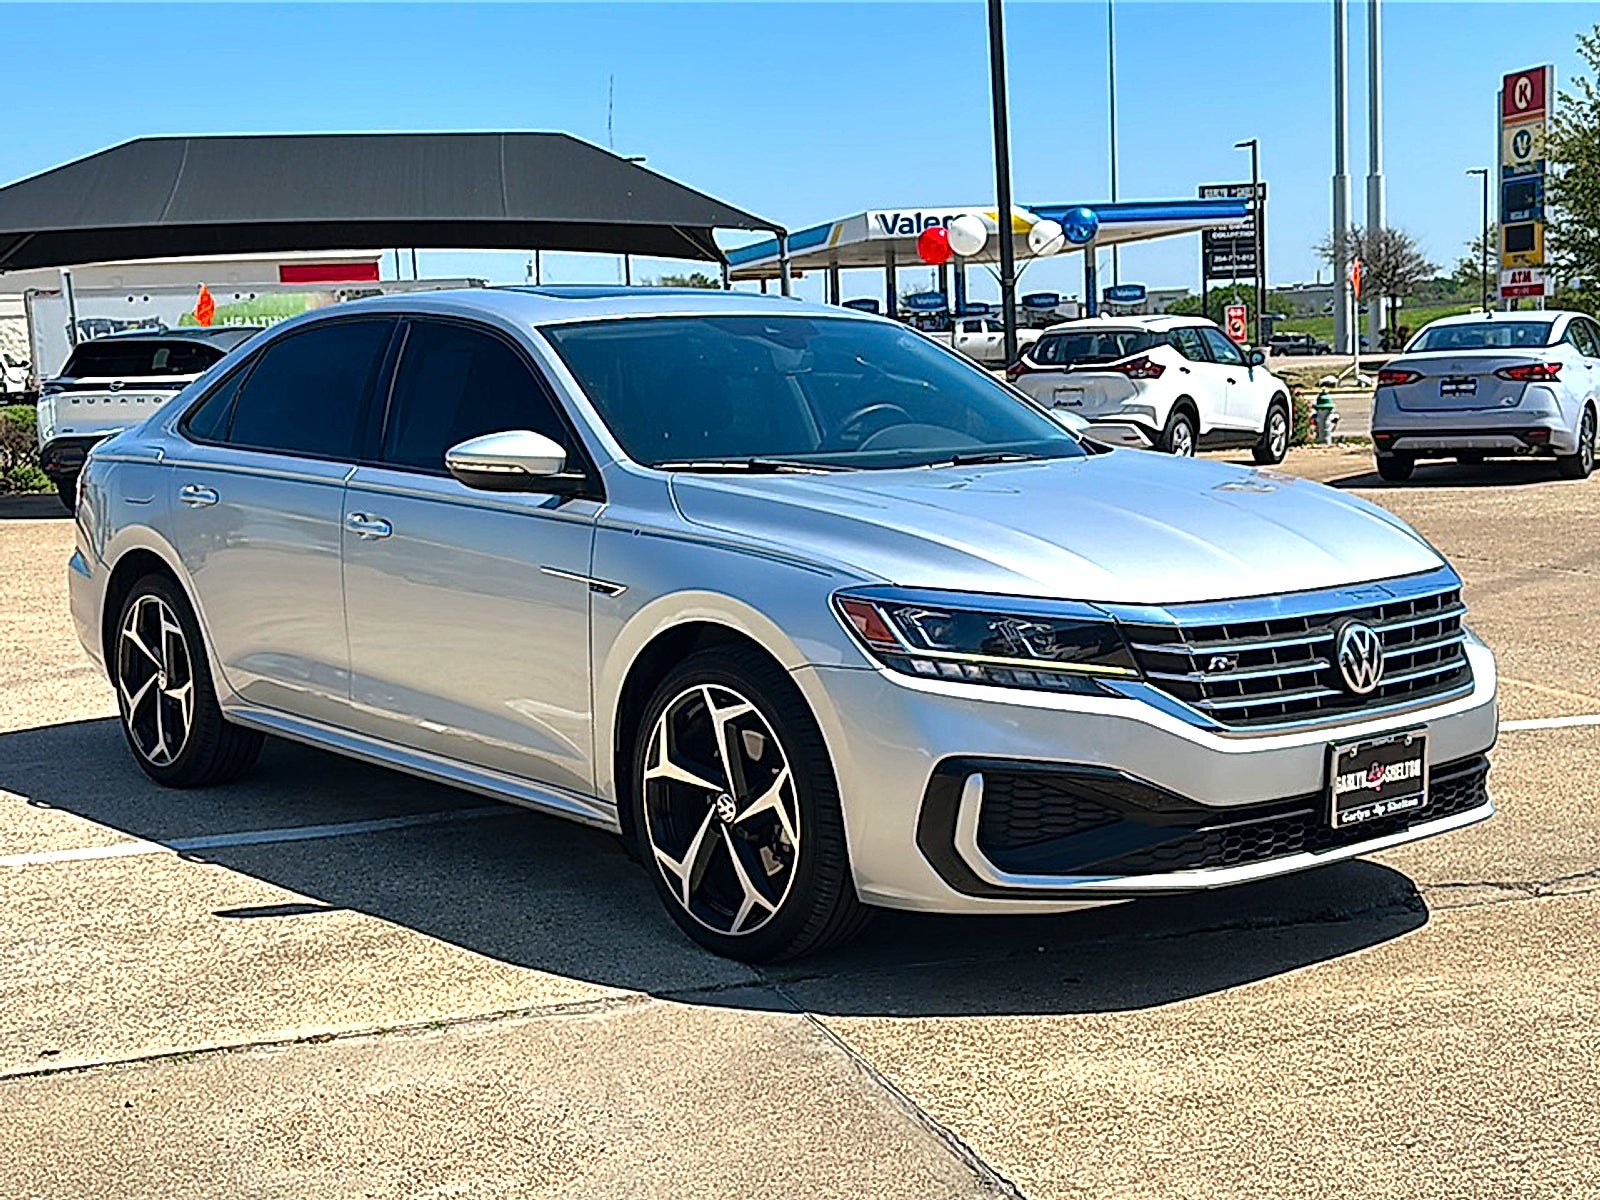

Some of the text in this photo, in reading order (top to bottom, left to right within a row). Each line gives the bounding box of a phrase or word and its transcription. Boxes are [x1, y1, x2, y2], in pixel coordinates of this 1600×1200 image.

[879, 211, 967, 235] Valer
[1510, 270, 1532, 284] ATM
[71, 396, 163, 405] MURANO
